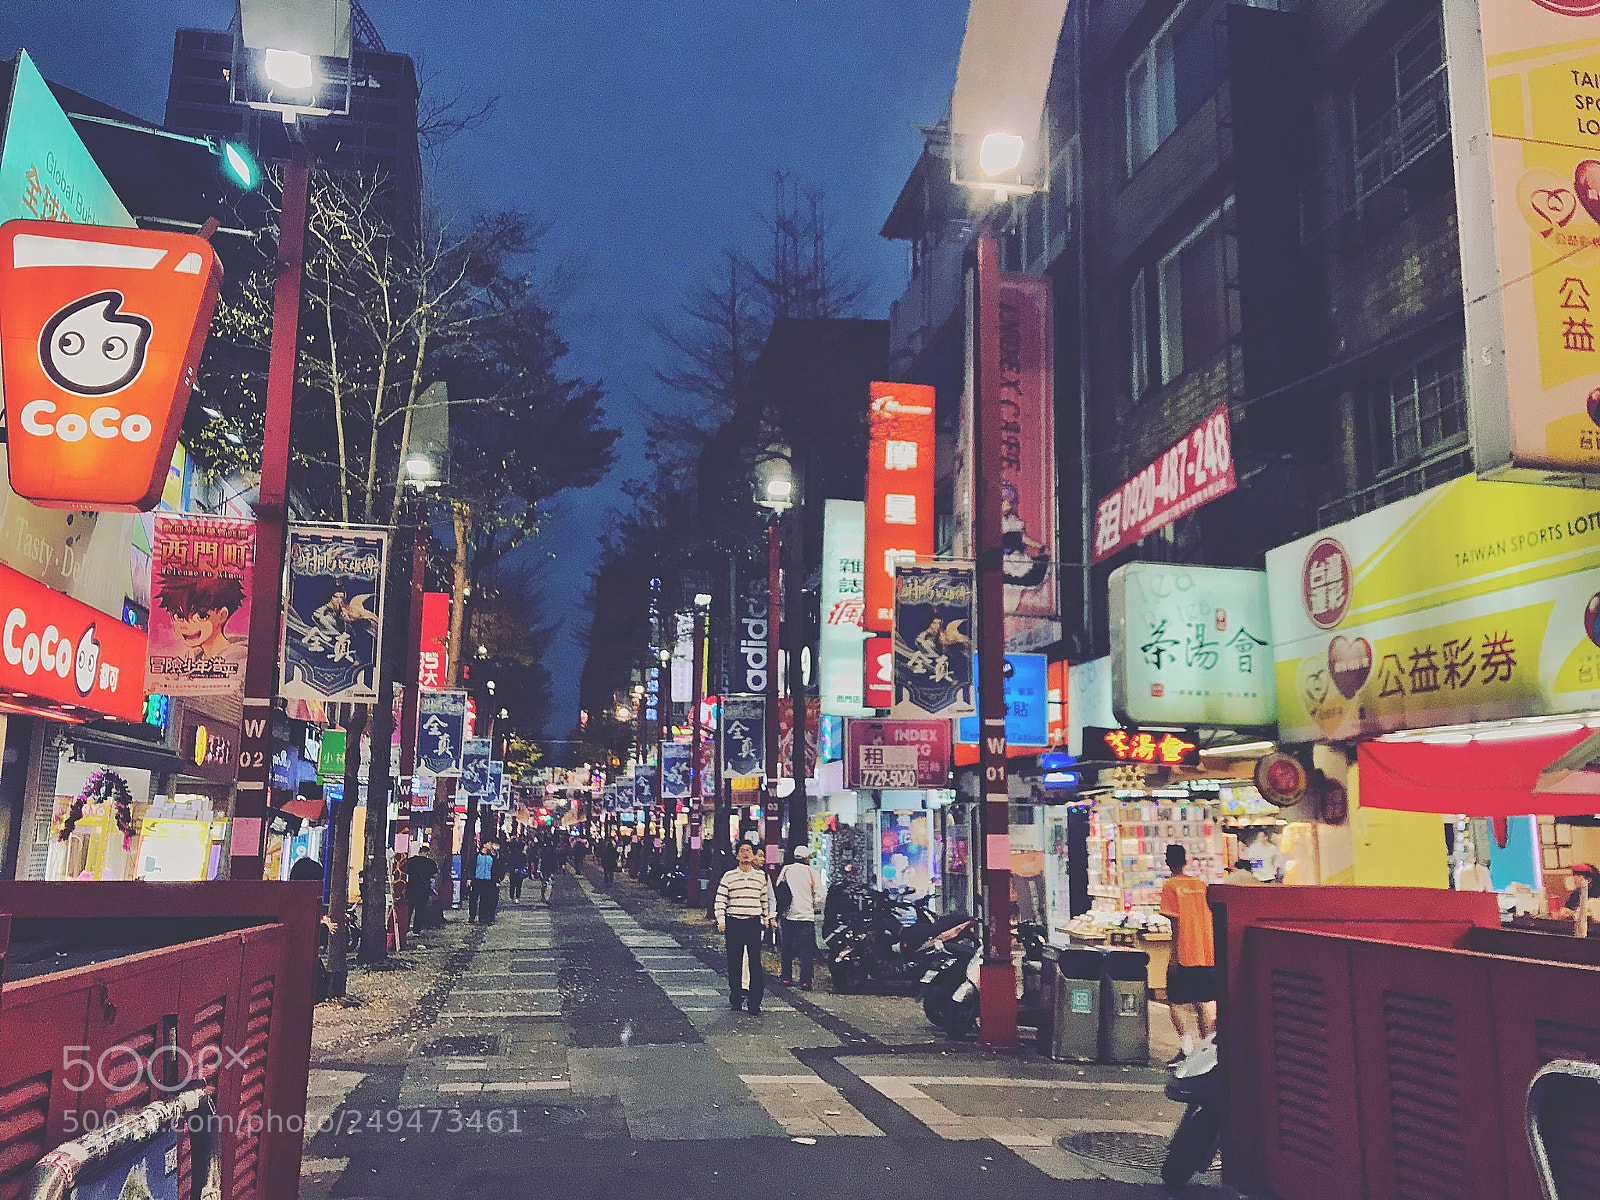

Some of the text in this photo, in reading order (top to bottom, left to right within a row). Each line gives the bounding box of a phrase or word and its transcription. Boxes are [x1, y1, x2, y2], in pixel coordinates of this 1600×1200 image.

[1571, 70, 1600, 89] TAI
[46, 151, 75, 204] Global
[1559, 276, 1596, 352] 公益
[20, 399, 152, 442] CoCo
[16, 516, 55, 577] Tasty
[159, 539, 250, 570] 西門町
[1455, 539, 1506, 567] TAIWAN
[1511, 523, 1563, 553] SPORTS
[160, 566, 199, 577] Welcome
[3, 607, 72, 679] CoCo
[302, 626, 357, 663] 全真
[1140, 618, 1269, 674] 茶湯會
[907, 650, 955, 683] 全真
[1378, 630, 1517, 698] 公益彩券
[244, 719, 267, 739] W
[422, 714, 455, 759] 全真
[894, 729, 938, 742] INDEX
[239, 751, 264, 768] 02
[864, 748, 884, 765] 租
[987, 737, 1006, 754] W
[1106, 731, 1195, 763] 茶湯會
[985, 766, 1005, 781] 01
[400, 785, 411, 795] W
